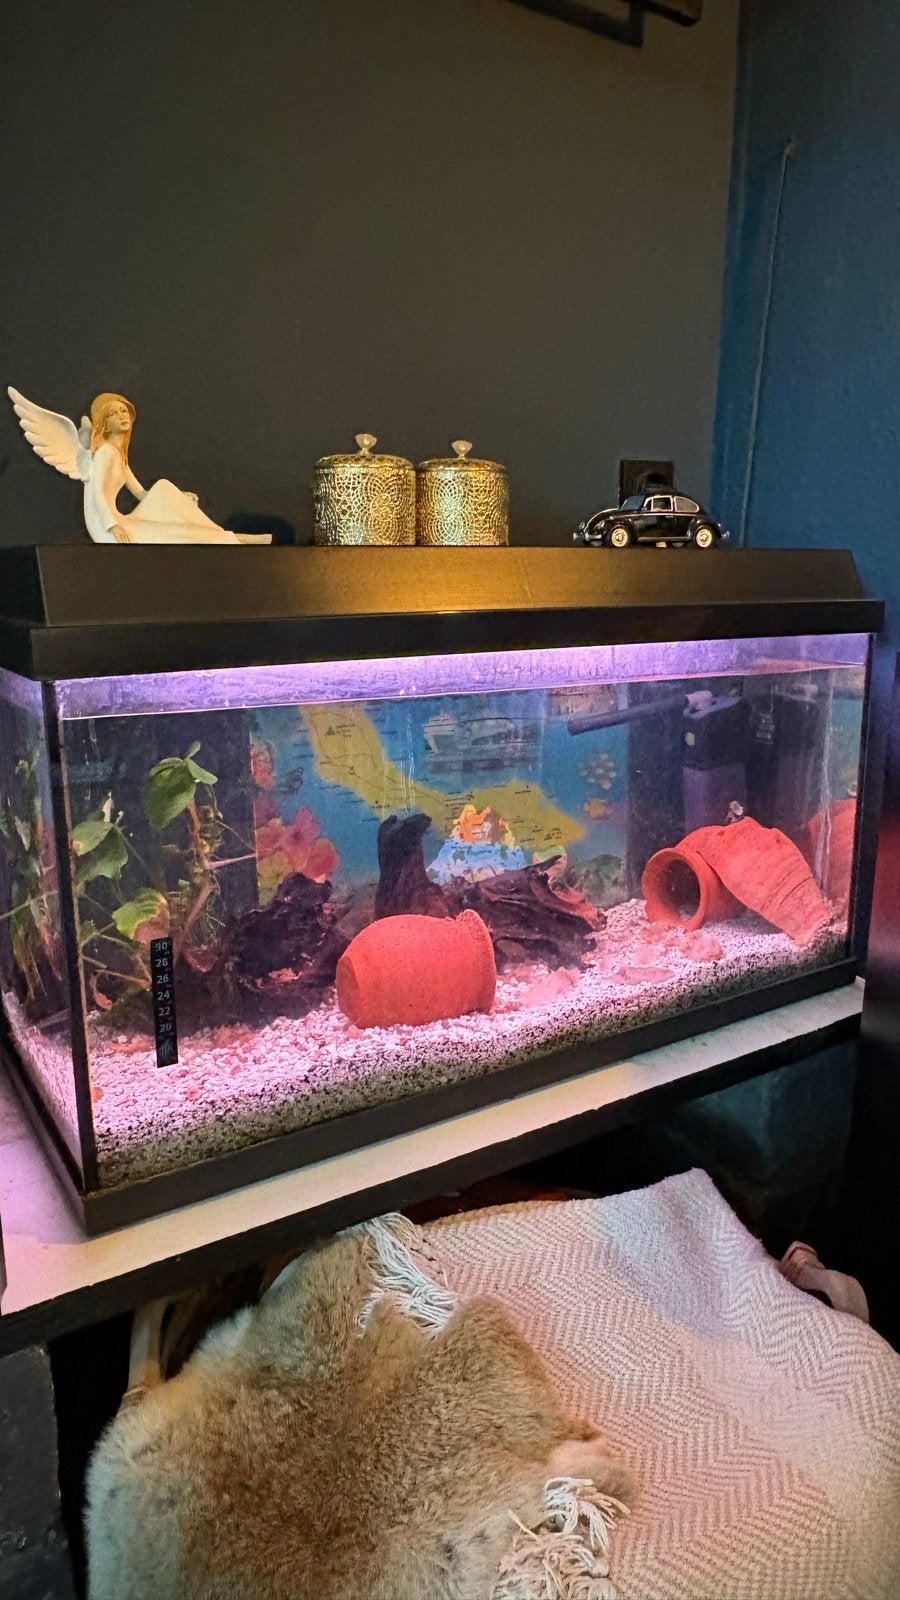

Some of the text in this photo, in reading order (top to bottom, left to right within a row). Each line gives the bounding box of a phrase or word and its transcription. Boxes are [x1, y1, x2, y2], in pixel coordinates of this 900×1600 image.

[157, 990, 170, 1001] 24
[158, 1006, 171, 1017] 22
[159, 1022, 172, 1033] 20
